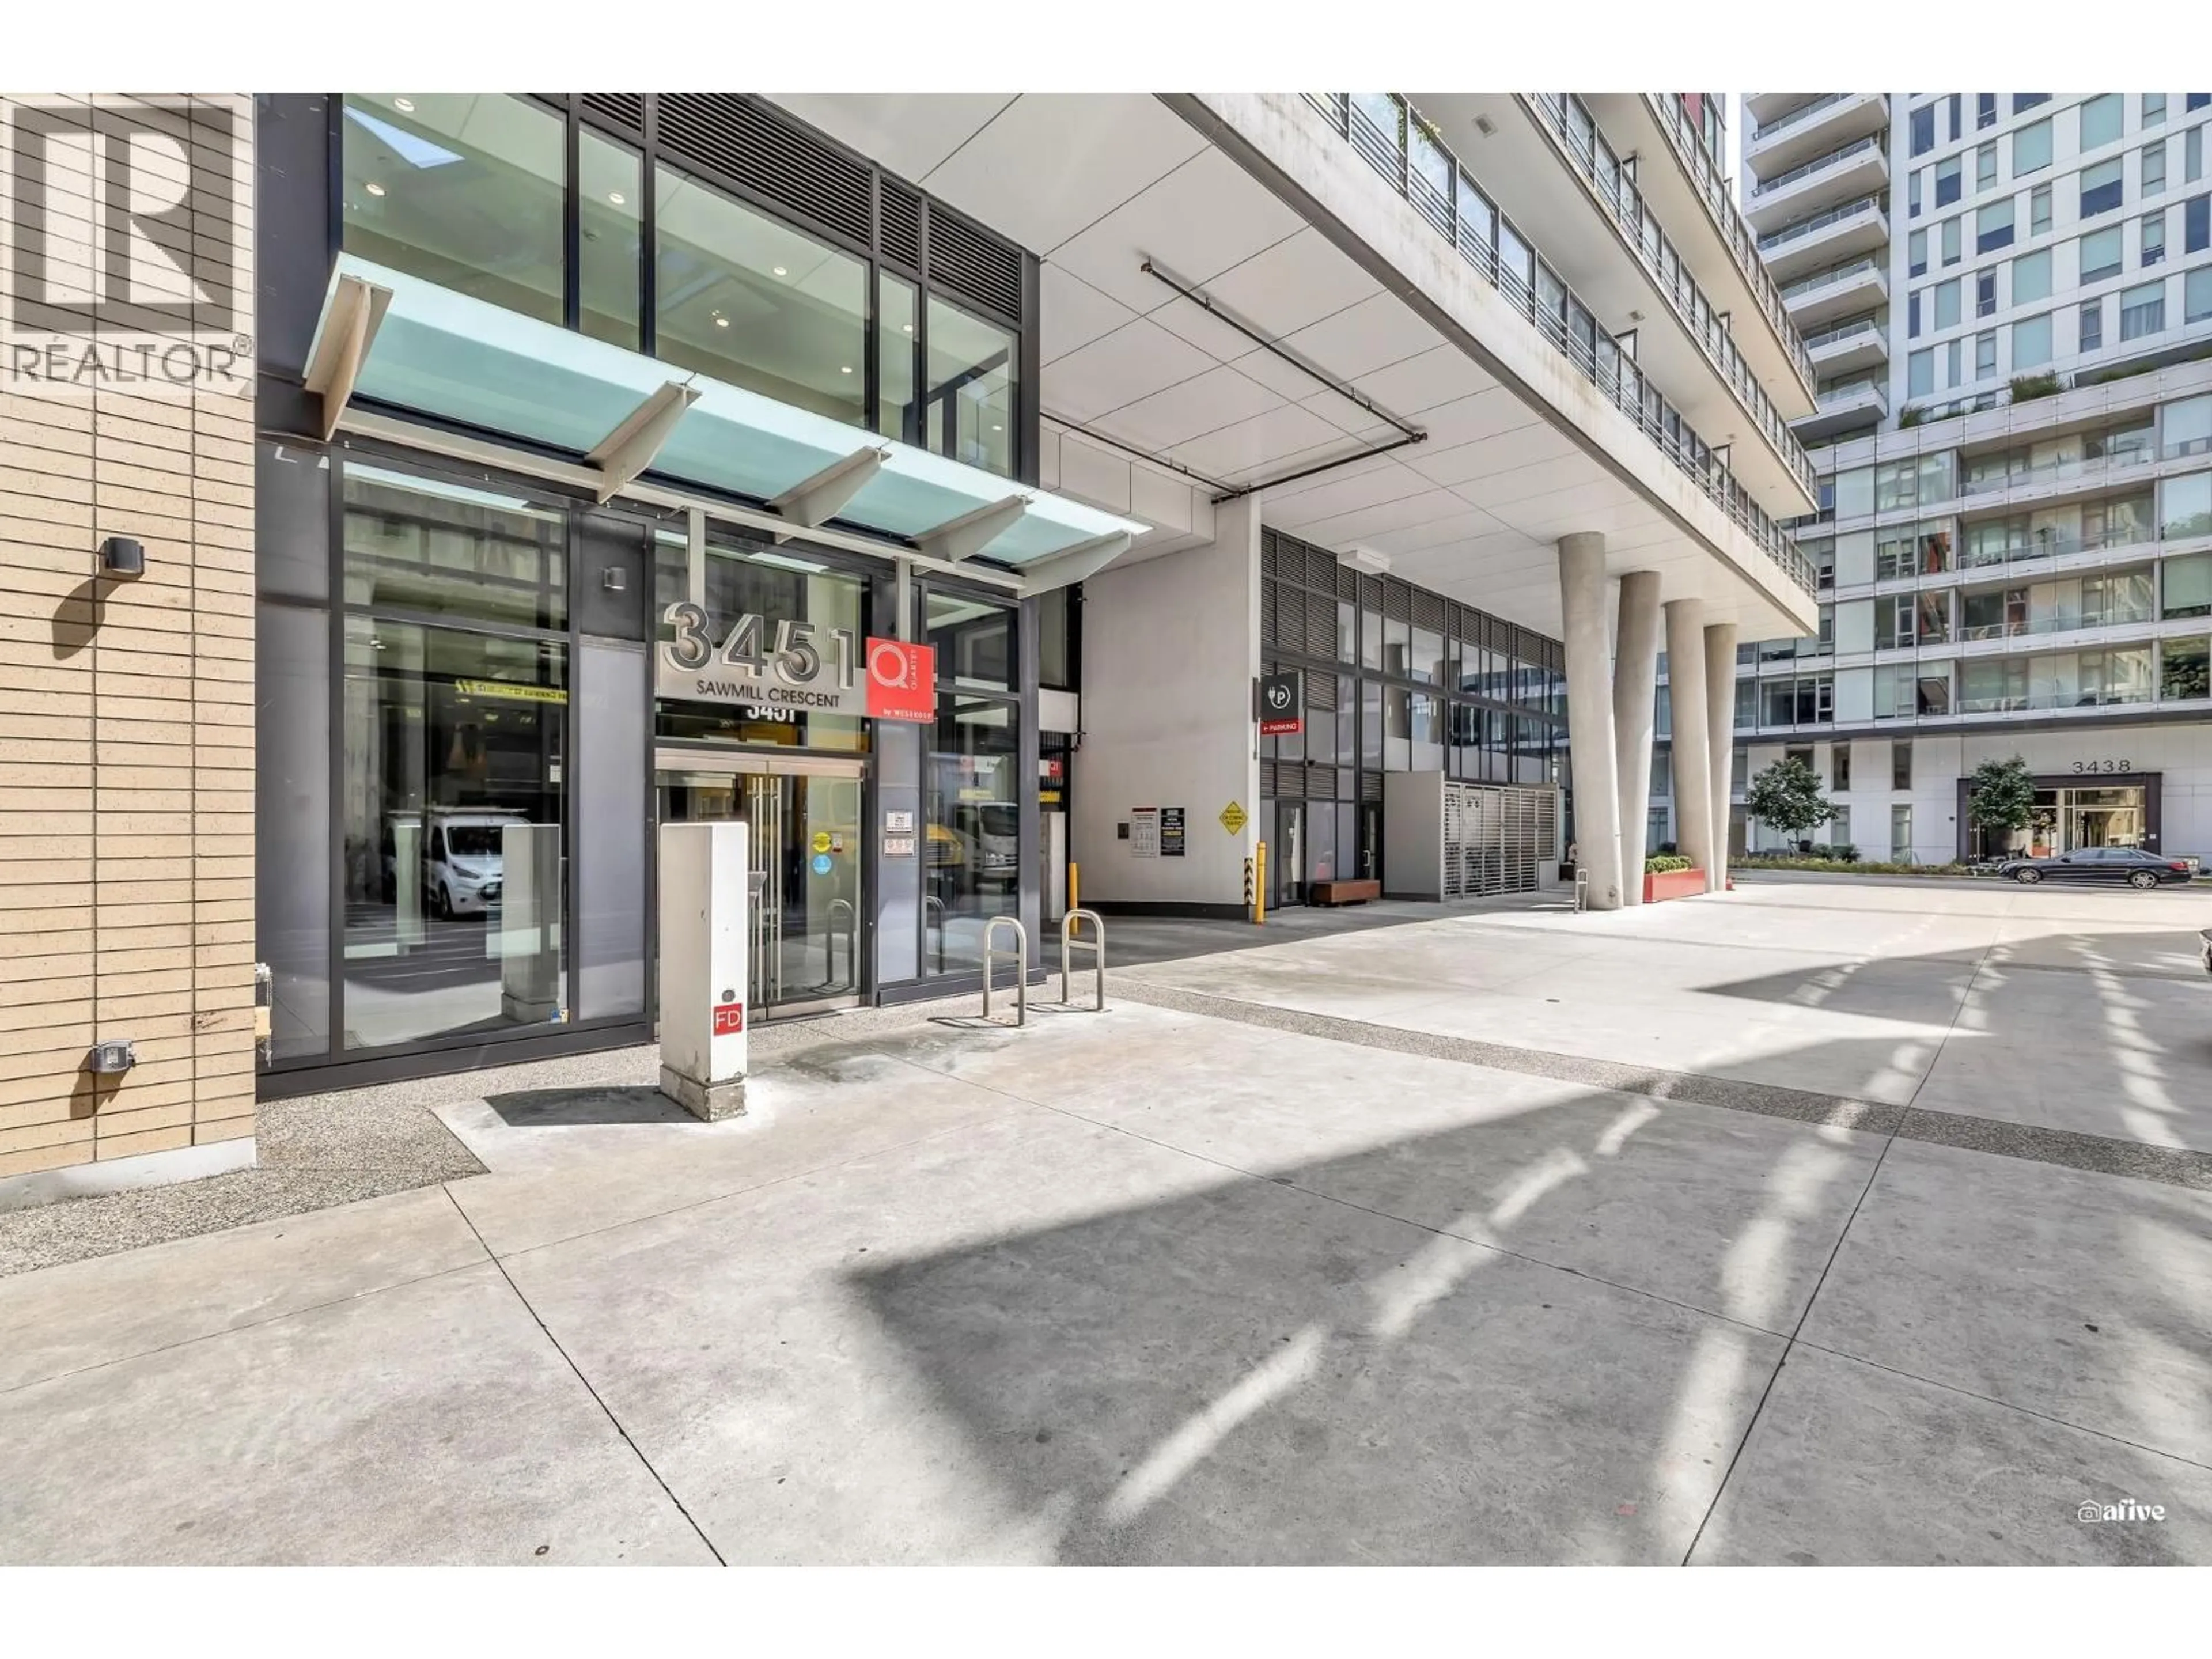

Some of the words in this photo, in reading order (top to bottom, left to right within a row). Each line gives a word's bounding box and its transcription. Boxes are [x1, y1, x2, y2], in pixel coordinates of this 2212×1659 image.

[664, 601, 855, 690] 3451
[870, 643, 909, 690] Q
[696, 680, 764, 701] SAWMILL
[768, 688, 840, 709] CRESCENT
[1277, 691, 1286, 704] P
[1269, 722, 1296, 731] PARKING
[2072, 760, 2130, 774] 3438
[715, 1010, 741, 1029] FD
